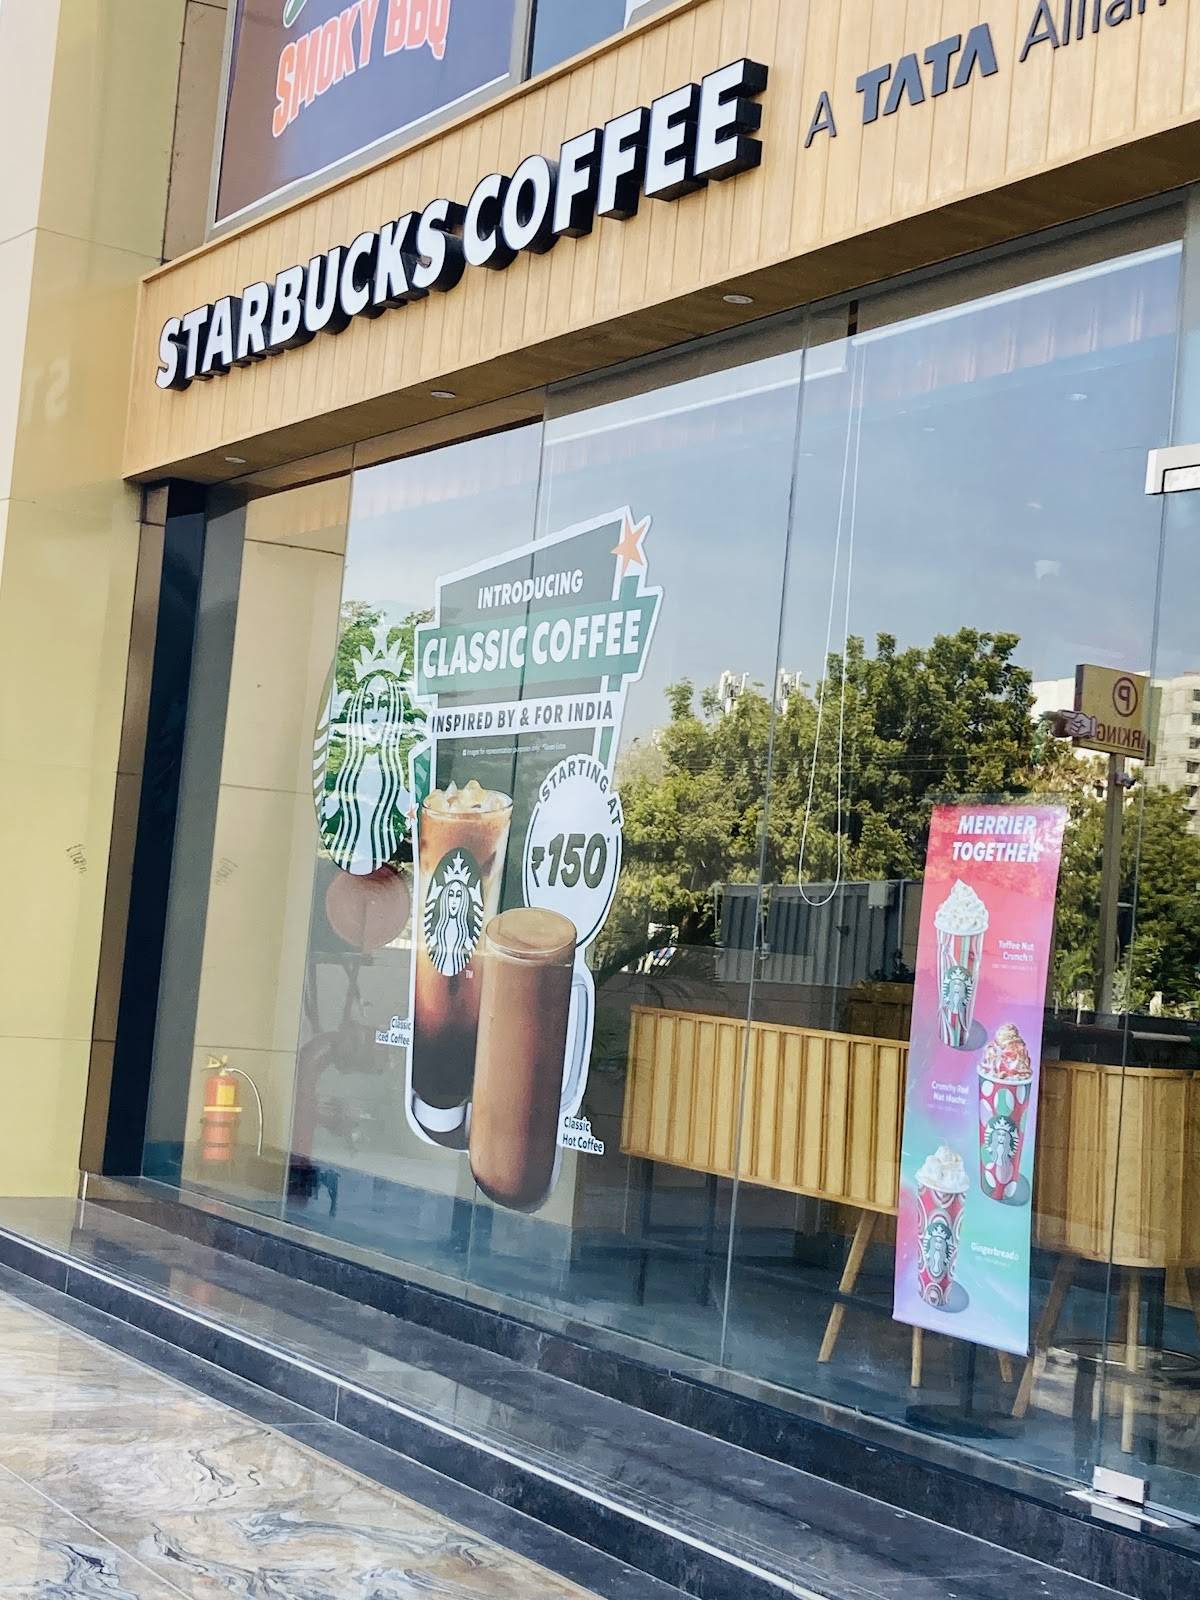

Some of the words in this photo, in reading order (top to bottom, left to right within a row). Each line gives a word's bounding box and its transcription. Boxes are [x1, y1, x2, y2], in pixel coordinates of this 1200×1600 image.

[272, 0, 379, 138] SMOKY
[804, 91, 837, 148] A
[856, 23, 998, 125] TATA
[155, 198, 462, 391] STARBUCKS
[463, 57, 764, 271] COFFEE
[478, 569, 583, 609] INTRODUCING
[422, 626, 528, 679] CLASSIC
[532, 609, 641, 665] COFFEE
[432, 711, 493, 733] INSPIRED
[497, 709, 516, 728] BY
[520, 707, 529, 726] &
[535, 705, 563, 724] FOR
[568, 701, 612, 721] INDIA
[542, 759, 608, 802] STARTING
[607, 797, 621, 824] AT
[957, 815, 1037, 835] MERRIER
[952, 841, 1038, 862] TOGETHER
[391, 1033, 410, 1045] Coffee
[564, 1116, 590, 1132] Classic
[562, 1134, 576, 1146] Hot
[578, 1136, 603, 1152] Coffee
